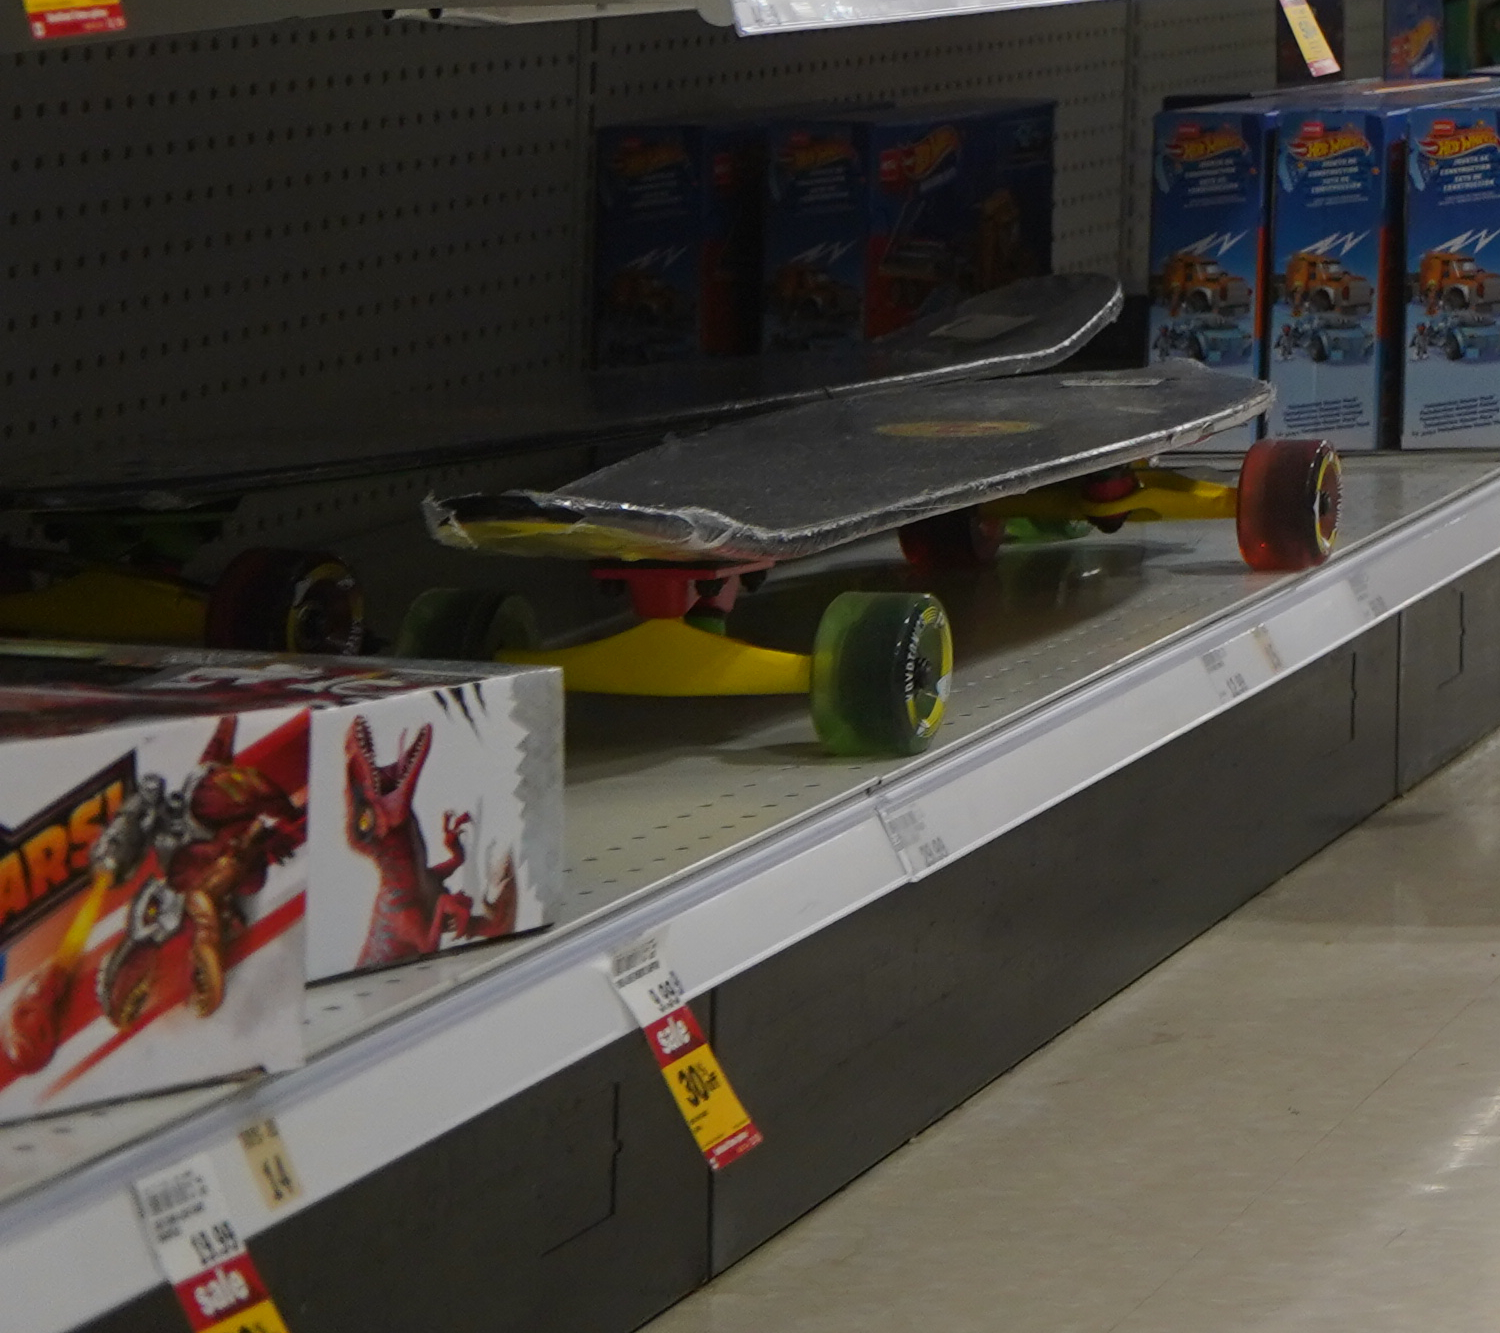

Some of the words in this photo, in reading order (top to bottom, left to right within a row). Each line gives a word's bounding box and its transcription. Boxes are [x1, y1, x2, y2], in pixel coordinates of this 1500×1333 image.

[1438, 133, 1461, 157] HOT
[655, 1016, 692, 1054] sale
[677, 1062, 716, 1107] 30%
[264, 1157, 292, 1201] 14
[193, 1266, 251, 1316] sale
